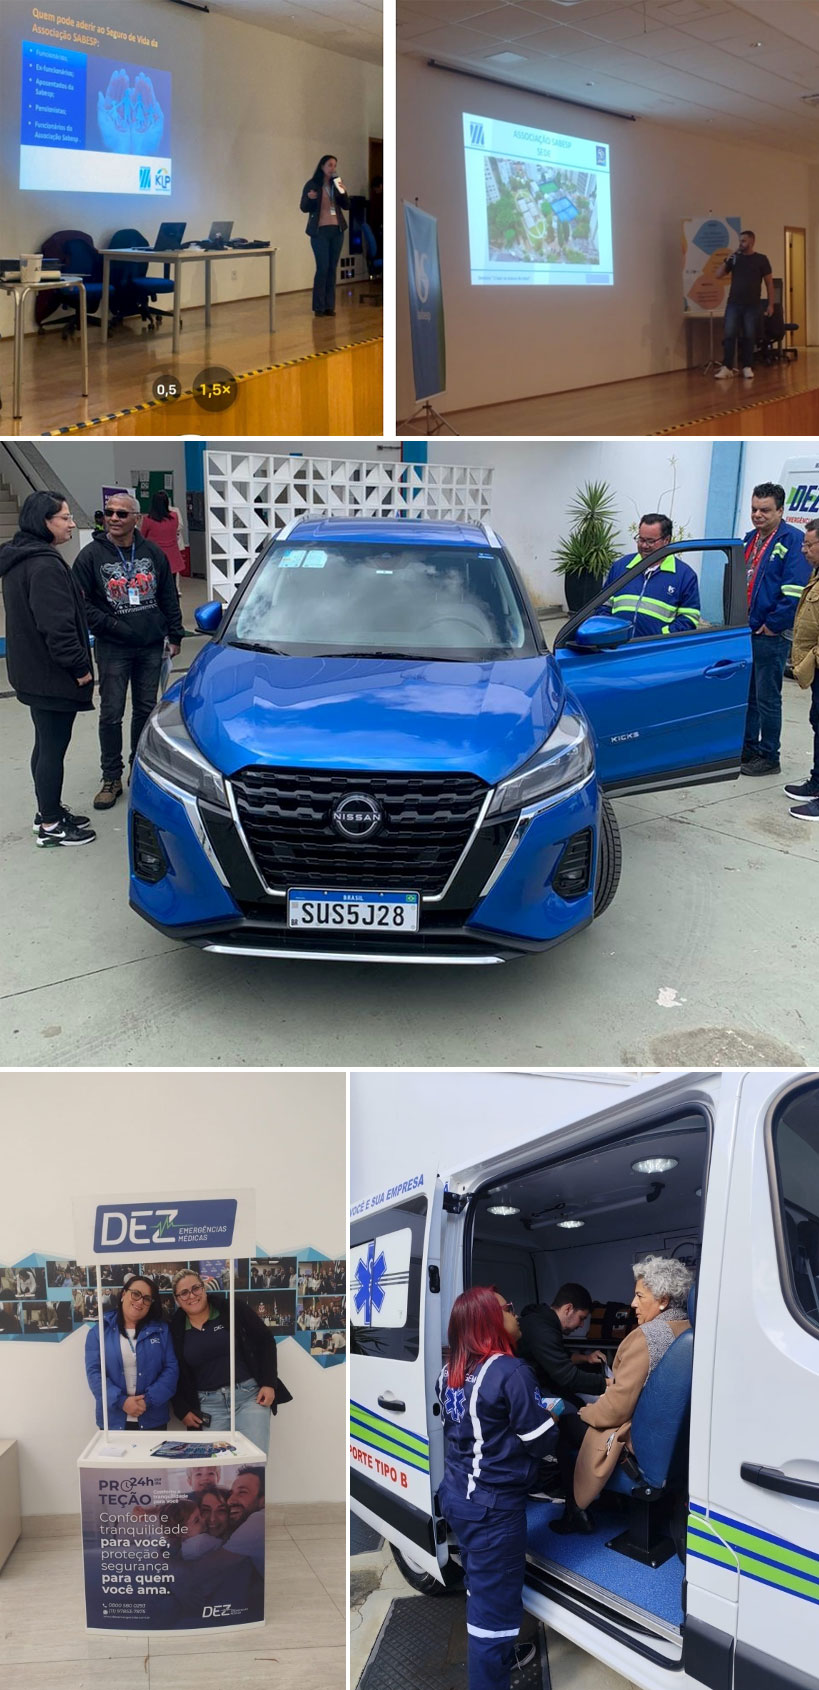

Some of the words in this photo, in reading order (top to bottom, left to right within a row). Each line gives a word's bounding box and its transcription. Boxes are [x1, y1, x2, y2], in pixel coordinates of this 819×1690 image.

[32, 7, 55, 22] Quem
[57, 16, 75, 27] pode
[76, 20, 96, 32] aderir
[97, 25, 105, 34] ao
[106, 27, 128, 40] Seguro
[128, 33, 137, 42] de
[136, 35, 150, 46] Vida
[150, 39, 158, 48] da
[32, 23, 72, 41] Associação
[73, 33, 100, 47] SABESP:
[513, 130, 551, 145] ASSOCIAÇÃO
[551, 137, 572, 149] SABESP
[536, 147, 551, 157] SEDE
[610, 731, 640, 743] KICKS
[334, 812, 381, 822] NISSAN
[343, 894, 364, 902] BRASIL
[302, 902, 405, 926] SUS5J28
[370, 1191, 385, 1207] SUA
[385, 1173, 424, 1201] EMPRESA
[101, 1209, 178, 1246] DEZ
[178, 1225, 227, 1235] EMERGÊNCIAS
[178, 1234, 208, 1242] MÉDICAS
[375, 1458, 397, 1482] TIPO
[400, 1471, 408, 1489] B
[98, 1492, 152, 1508] TEÇÃO
[99, 1512, 157, 1523] Conforto
[160, 1514, 169, 1522] e
[99, 1523, 189, 1537] tranquilidade
[100, 1538, 130, 1549] para
[134, 1536, 171, 1549] você,
[101, 1549, 159, 1561] proteção
[162, 1550, 170, 1559] e
[101, 1562, 169, 1574] segurança
[102, 1574, 131, 1585] para
[135, 1574, 175, 1585] quem
[102, 1584, 133, 1595] você
[137, 1586, 171, 1595] ama.
[202, 1604, 232, 1618] DEZ
